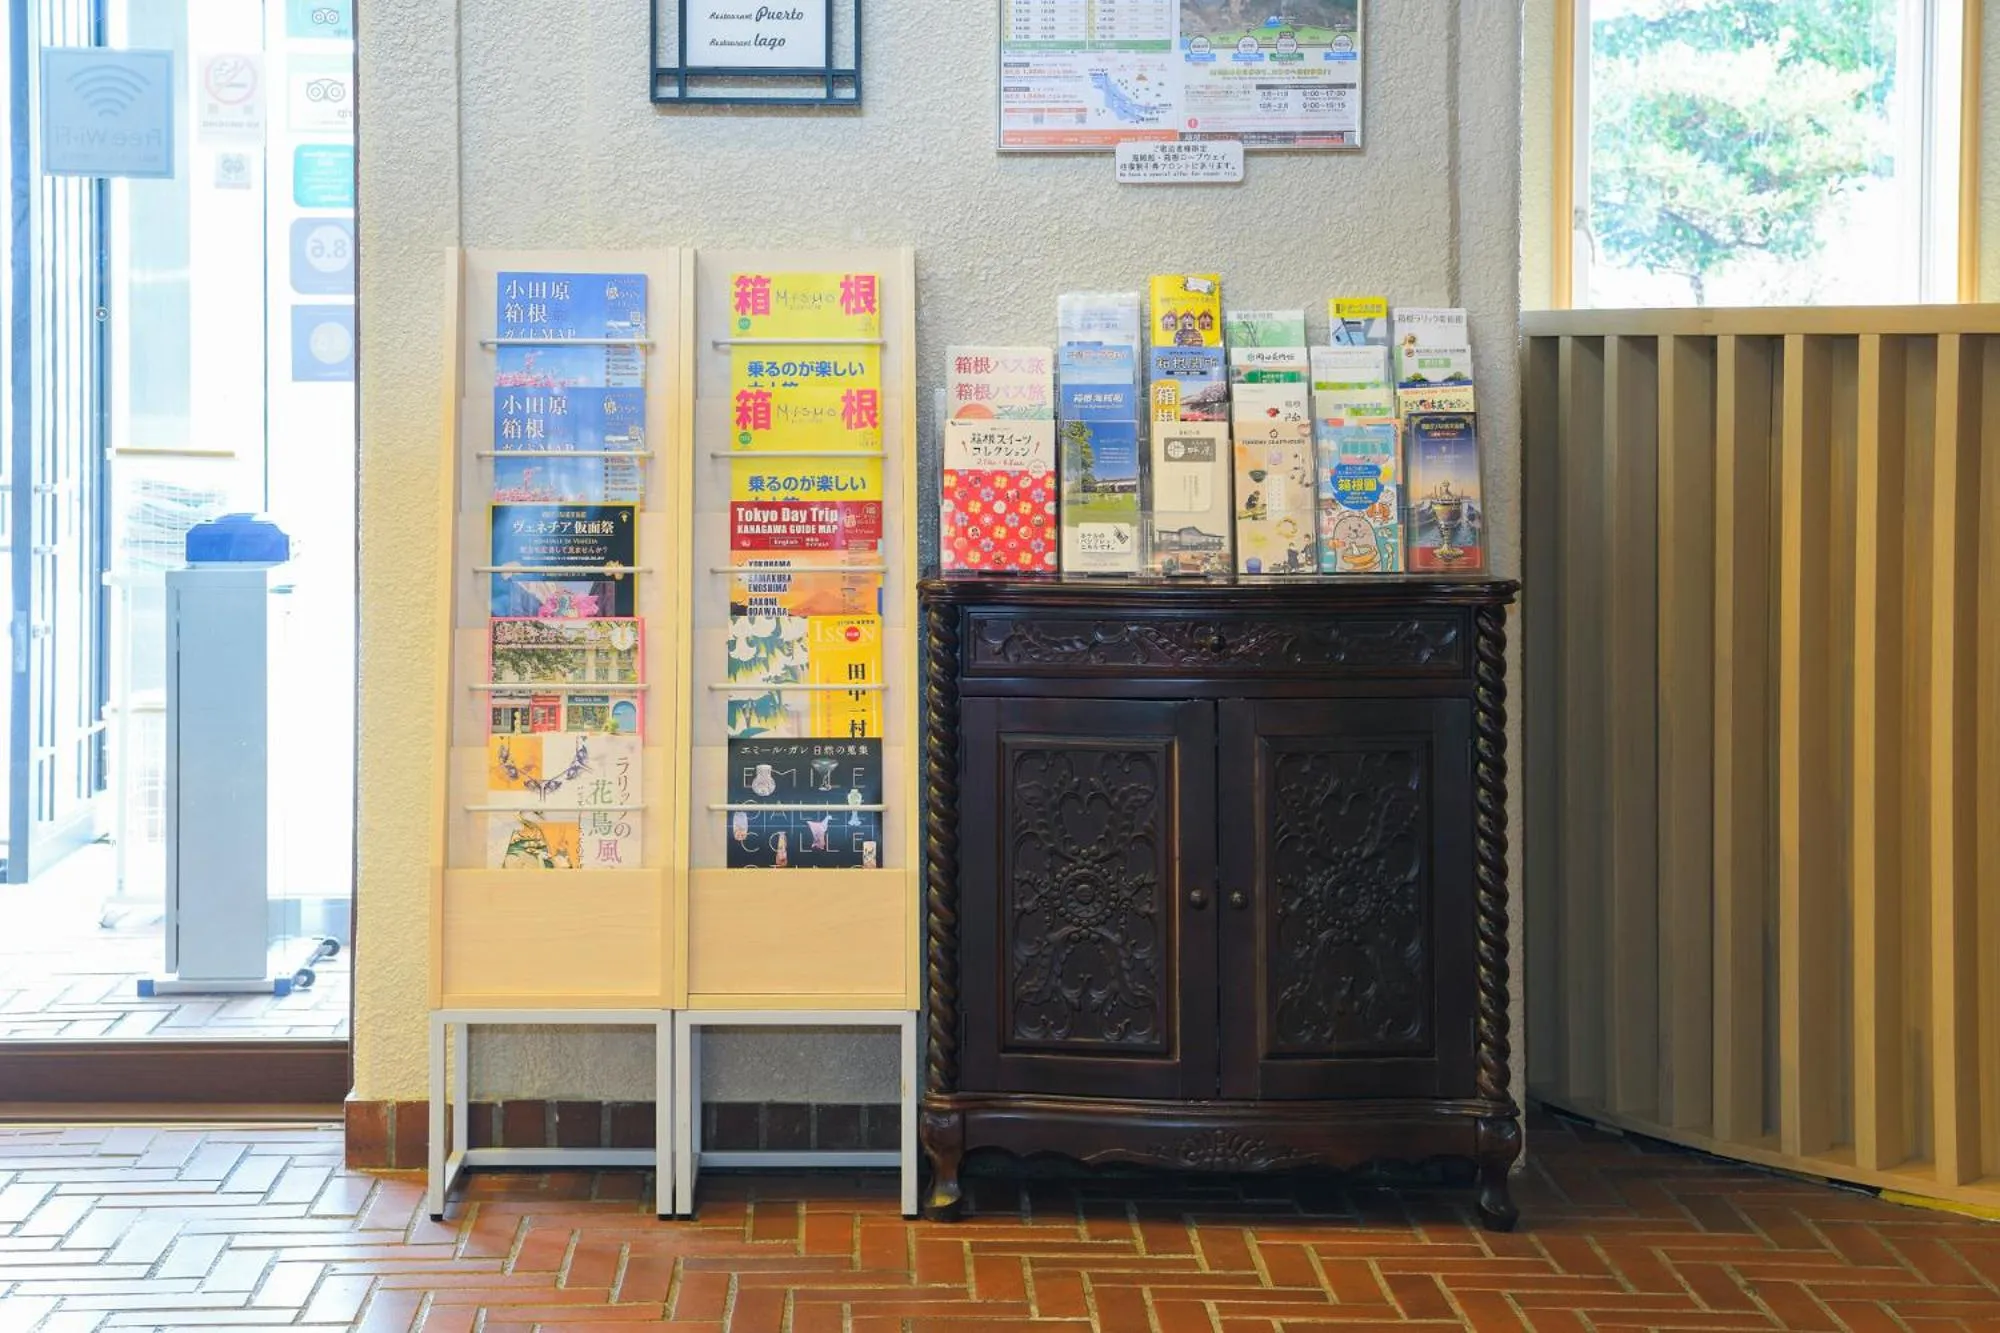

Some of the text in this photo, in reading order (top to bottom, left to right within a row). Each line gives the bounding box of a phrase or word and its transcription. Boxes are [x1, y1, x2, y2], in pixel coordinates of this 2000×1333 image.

[709, 6, 804, 22] Restaurant Puerto
[709, 33, 786, 50] Restaurant lago
[504, 279, 570, 300] 小田原
[504, 303, 547, 323] 箱根
[748, 360, 865, 377] 乗るのが楽しい
[955, 356, 1046, 375] 箱根バス旅
[955, 383, 1046, 401] 箱根バス旅
[502, 395, 568, 416] 小田原
[502, 418, 545, 440] 箱根
[970, 432, 1032, 445] 箱根スイーツ
[972, 446, 1030, 457] コレクション
[748, 475, 867, 492] 乗るのが楽しい
[737, 507, 778, 523] Tokyo
[782, 508, 807, 523] Day
[810, 507, 838, 523] Trip
[512, 520, 614, 534] ヴェネチア 仮面祭
[737, 525, 838, 534] KANAGAWA GUIDE MAP
[748, 574, 792, 583] KAMAKURA
[748, 583, 787, 592] ENOSHIMA
[748, 598, 777, 606] HAKONE
[748, 607, 788, 616] ODAWARA
[814, 620, 875, 643] ISSN
[739, 799, 866, 821] GALL
